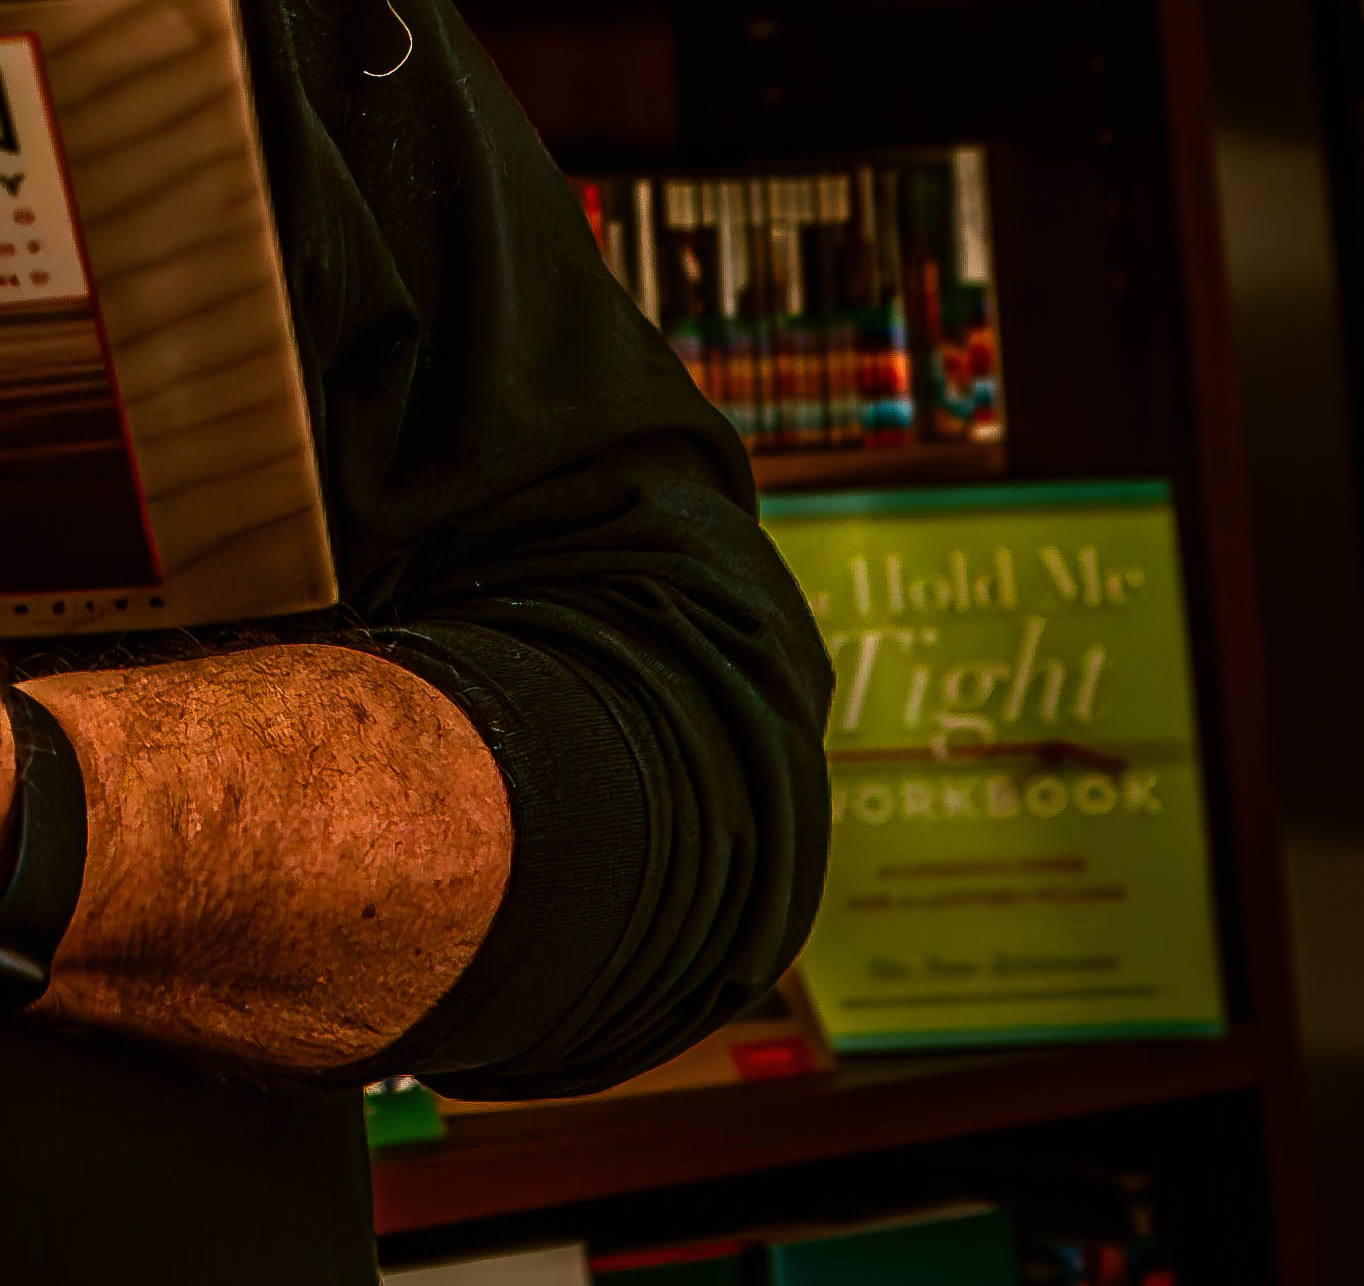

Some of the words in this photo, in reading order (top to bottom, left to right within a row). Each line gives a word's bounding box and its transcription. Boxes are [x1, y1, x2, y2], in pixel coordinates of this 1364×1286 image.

[849, 546, 1019, 617] Hold
[1041, 544, 1148, 607] Me
[830, 615, 1106, 762] Tight
